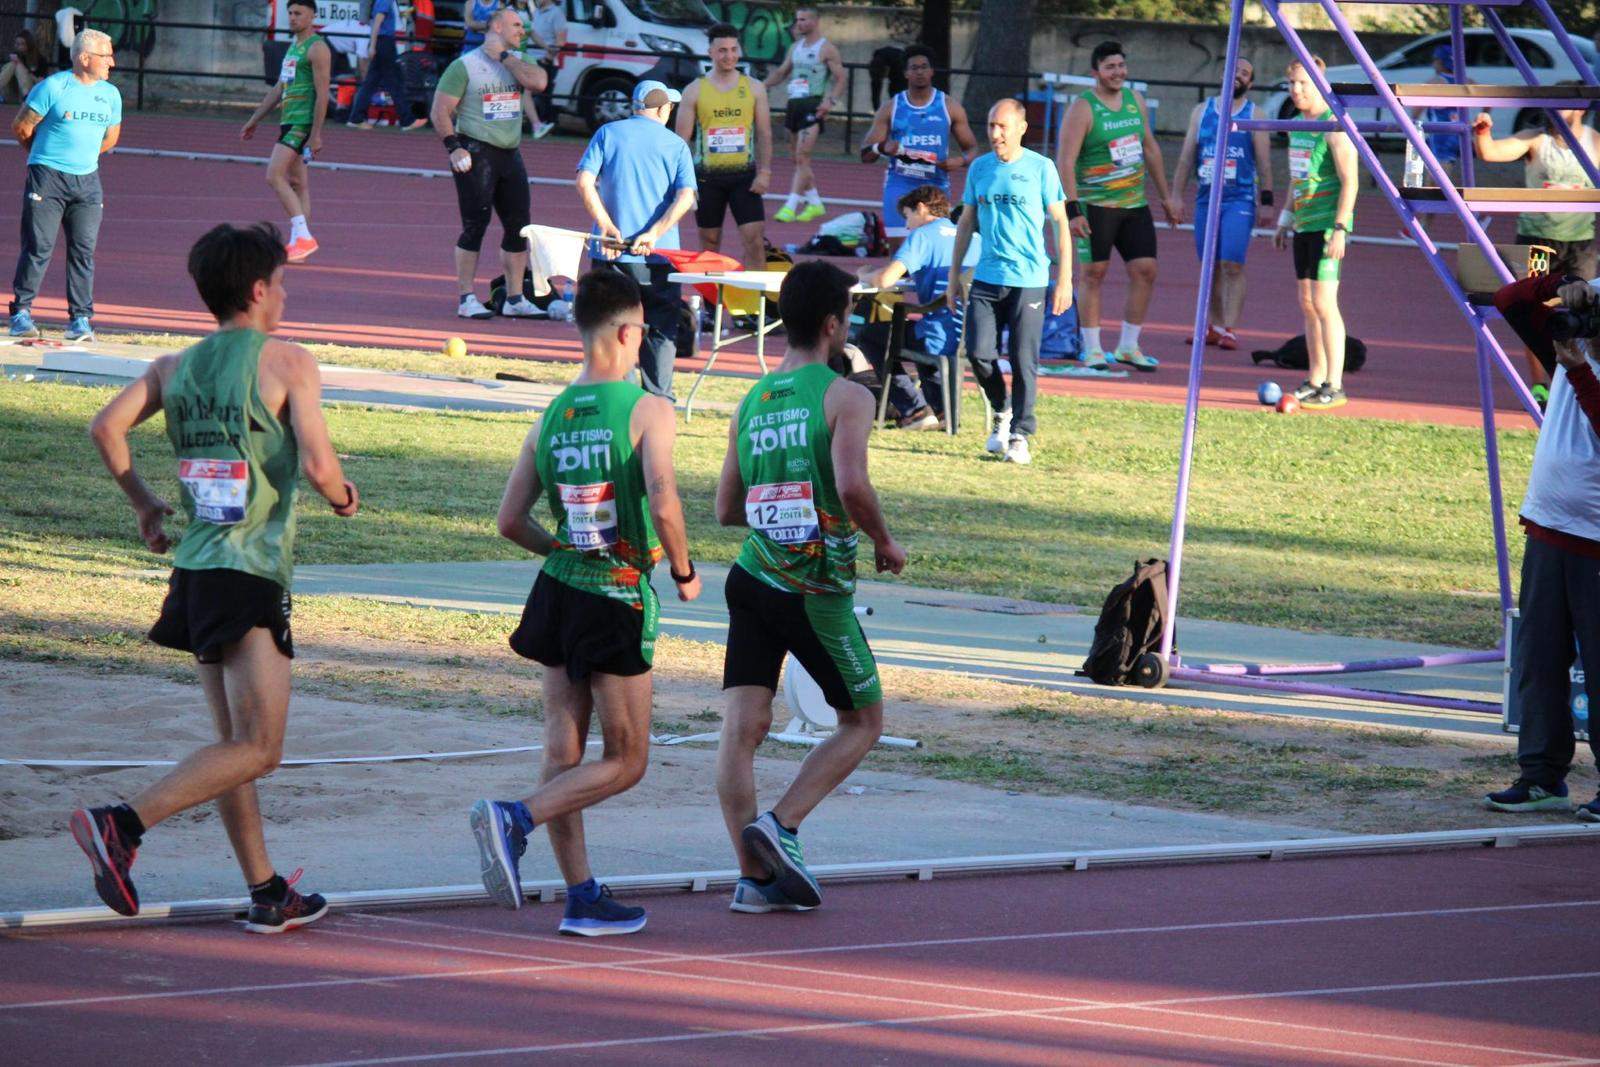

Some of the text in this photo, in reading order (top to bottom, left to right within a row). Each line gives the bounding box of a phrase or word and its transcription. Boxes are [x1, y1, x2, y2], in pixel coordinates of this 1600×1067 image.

[330, 4, 360, 21] Roja
[489, 102, 503, 111] 22
[713, 107, 742, 118] teiko
[1103, 117, 1141, 131] Huesca
[712, 136, 724, 145] 20
[1201, 146, 1245, 158] ALSA
[978, 193, 1027, 206] ALPESA
[748, 407, 810, 429] ATLETISMO
[749, 421, 808, 456] ZOITI
[754, 504, 778, 525] 12
